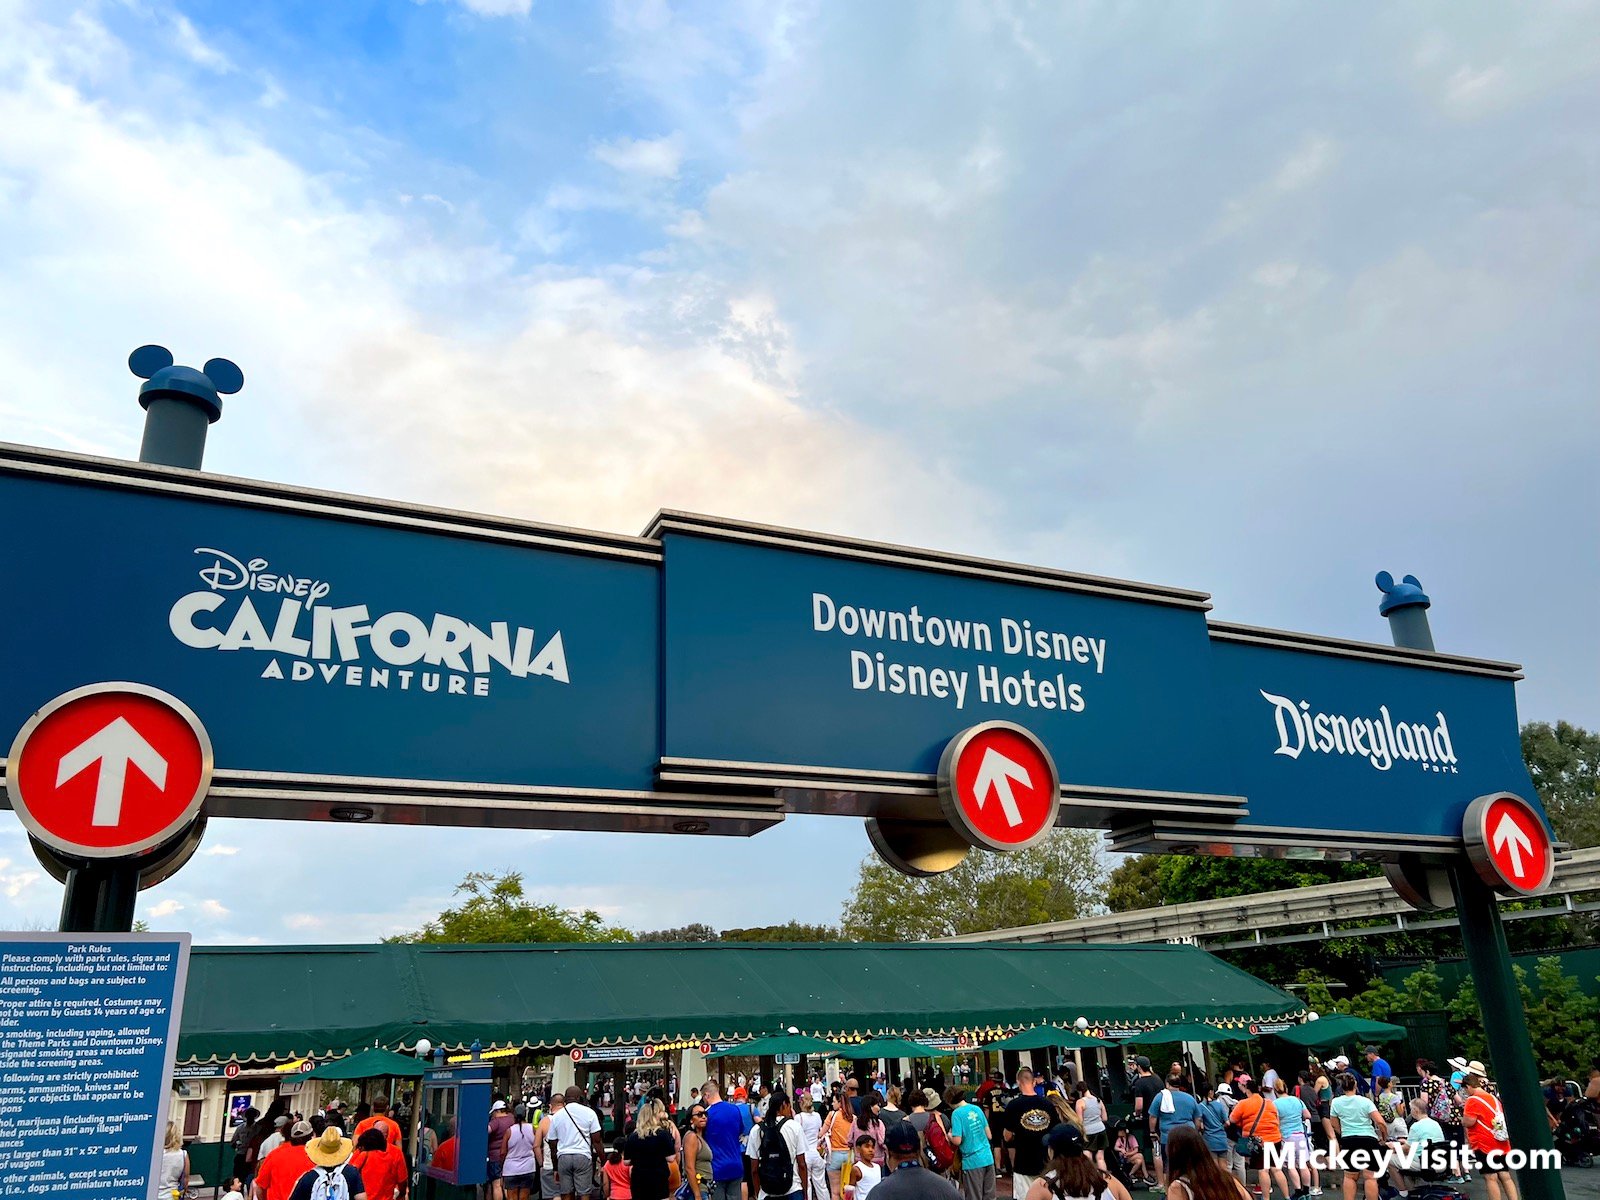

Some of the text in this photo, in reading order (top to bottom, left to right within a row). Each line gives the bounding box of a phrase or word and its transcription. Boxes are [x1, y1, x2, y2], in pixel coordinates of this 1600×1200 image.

[168, 590, 571, 684] CALIFORNIA
[812, 592, 1106, 674] Downtown Disney
[260, 658, 490, 697] ADVENTURE
[850, 650, 1086, 713] Disney Hotels
[1259, 688, 1458, 771] Disneyland
[3, 954, 30, 962] Please
[33, 955, 62, 964] comply
[65, 954, 84, 962] with
[86, 954, 105, 963] park
[132, 954, 152, 963] signs
[1, 963, 53, 973] instructions,
[56, 963, 94, 973] including
[96, 963, 110, 972] but
[69, 977, 88, 986] bags
[107, 977, 136, 986] subject
[0, 986, 42, 995] screening.
[63, 999, 101, 1008] required.
[144, 999, 162, 1007] may
[52, 1008, 62, 1018] by
[64, 1008, 91, 1016] Guests
[104, 1008, 127, 1017] years
[139, 1008, 154, 1016] age
[46, 1029, 84, 1038] including
[118, 1027, 150, 1036] allowed
[48, 1039, 70, 1047] Parks
[73, 1038, 88, 1047] and
[90, 1038, 133, 1046] Downtown
[136, 1037, 163, 1045] Disney.
[0, 1049, 37, 1059] signated
[39, 1048, 73, 1058] smoking
[76, 1049, 98, 1057] areas
[115, 1047, 144, 1055] located
[22, 1059, 35, 1068] the
[37, 1058, 76, 1068] screening
[79, 1058, 104, 1066] areas.
[302, 1063, 311, 1072] 10
[3, 1072, 44, 1082] following
[63, 1071, 93, 1082] strictly
[93, 1070, 139, 1081] prohibited:
[229, 1066, 236, 1075] 11
[29, 1084, 82, 1094] ammunition,
[85, 1083, 111, 1091] knives
[113, 1082, 129, 1090] and
[41, 1094, 70, 1103] objects
[91, 1093, 120, 1101] appear
[17, 1117, 60, 1127] marijuana
[63, 1116, 104, 1126] (including
[106, 1113, 152, 1124] marijuana-
[18, 1126, 59, 1138] products)
[61, 1125, 77, 1135] and
[79, 1126, 95, 1135] any
[97, 1123, 122, 1134] illegal
[14, 1151, 41, 1160] larger
[43, 1148, 61, 1157] than
[104, 1145, 120, 1154] and
[122, 1146, 137, 1155] any
[0, 1160, 45, 1170] of wagons
[3, 1168, 128, 1183] other animals, except service
[28, 1184, 49, 1195] dogs
[51, 1183, 68, 1191] and
[70, 1179, 111, 1191] miniature
[114, 1176, 144, 1187] horses)
